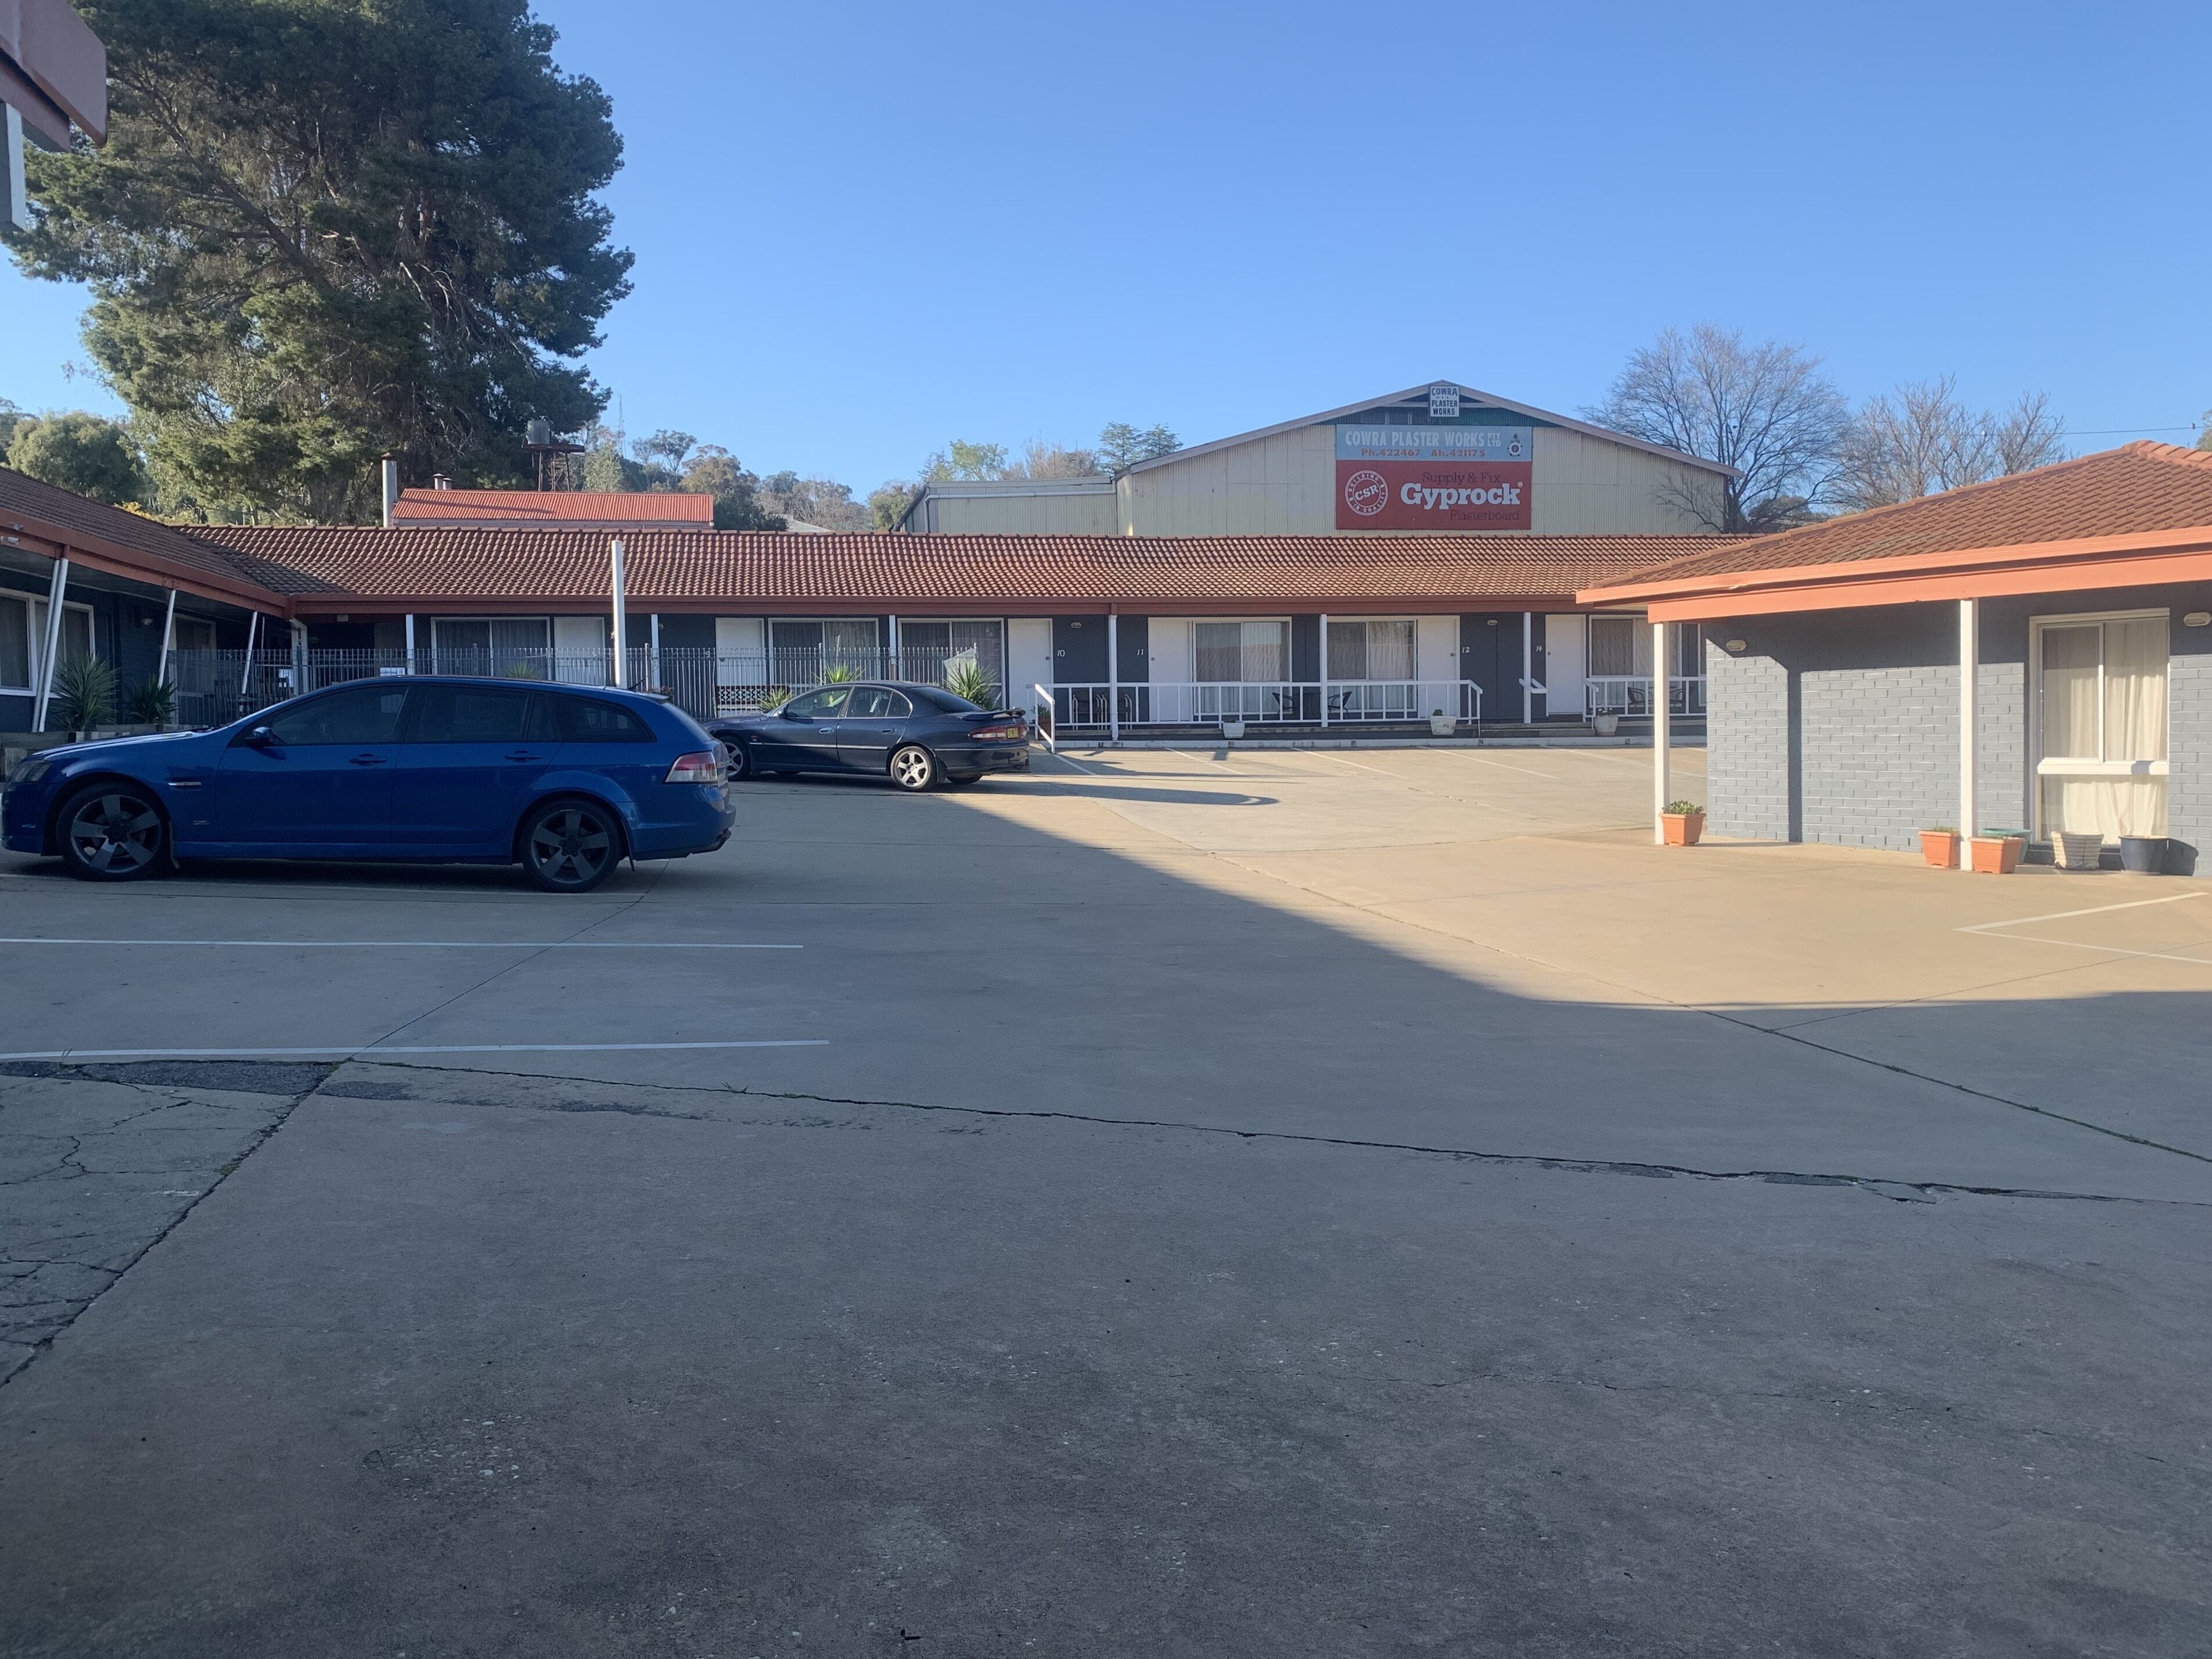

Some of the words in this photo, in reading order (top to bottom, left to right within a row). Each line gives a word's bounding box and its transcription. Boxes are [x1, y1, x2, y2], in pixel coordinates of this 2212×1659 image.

[1431, 387, 1458, 396] COWRA
[1346, 430, 1387, 446] COWRA
[1392, 432, 1440, 446] PLASTER
[1444, 432, 1485, 447] WORKS
[1348, 473, 1379, 492] BUILDING
[1423, 472, 1465, 485] Supply
[1468, 472, 1477, 483] &
[1481, 473, 1501, 483] Fix
[1355, 484, 1379, 500] CSR
[1400, 482, 1520, 510] Gyprock
[1363, 491, 1386, 512] QUALITY
[1450, 510, 1519, 520] Plasterboard
